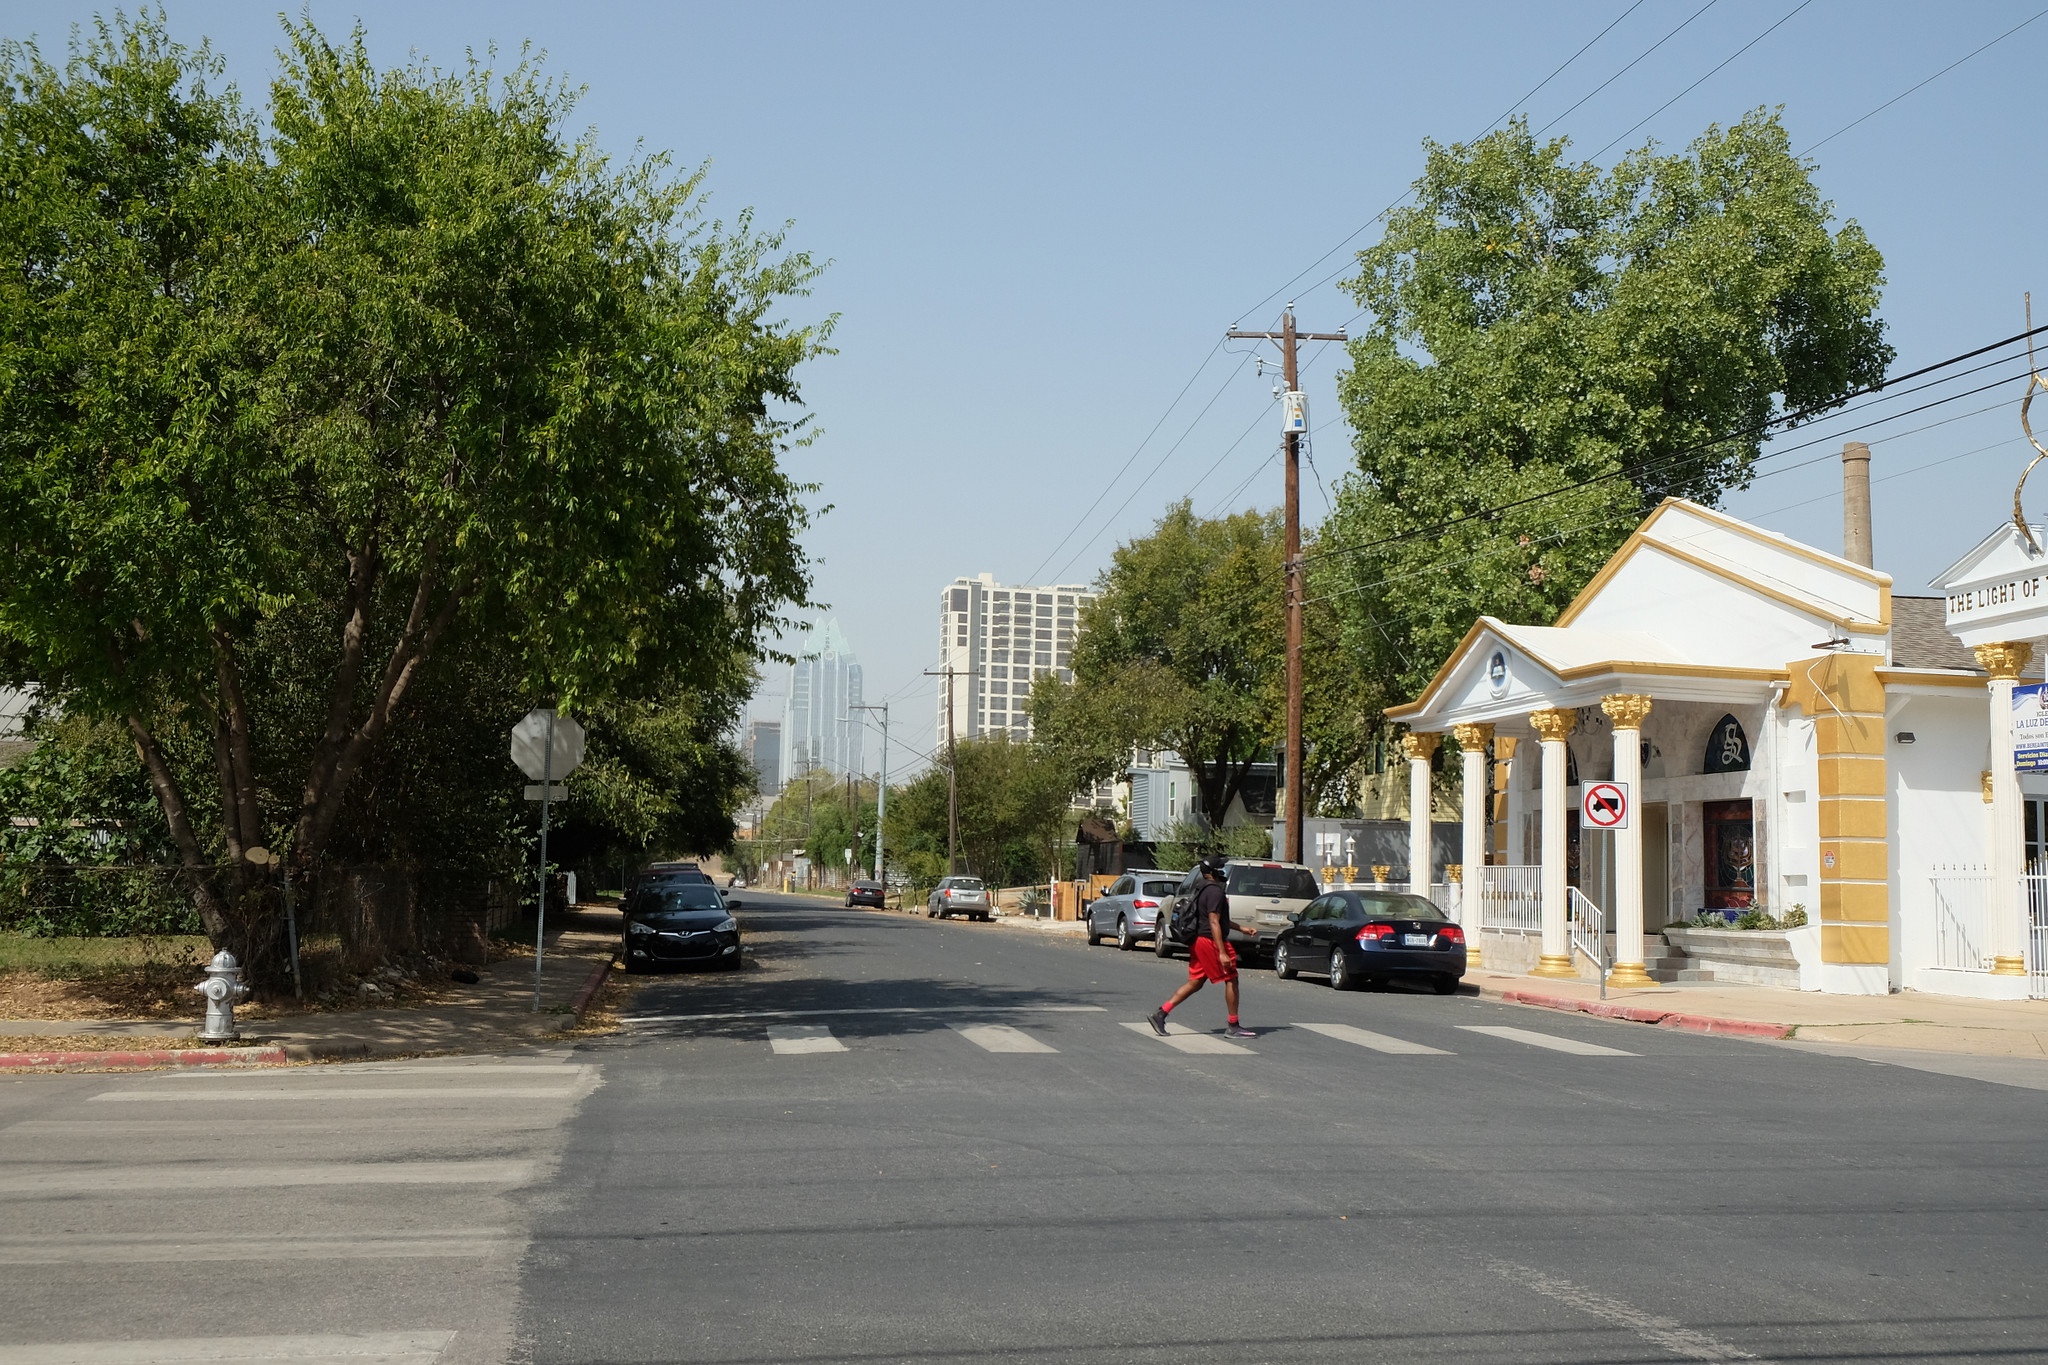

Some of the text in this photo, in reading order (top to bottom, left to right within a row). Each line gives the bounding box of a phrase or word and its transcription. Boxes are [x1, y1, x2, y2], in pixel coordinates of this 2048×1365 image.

[1949, 578, 2039, 614] THE LIGHT OF
[2016, 720, 2024, 728] LA
[2026, 718, 2038, 728] LUZ
